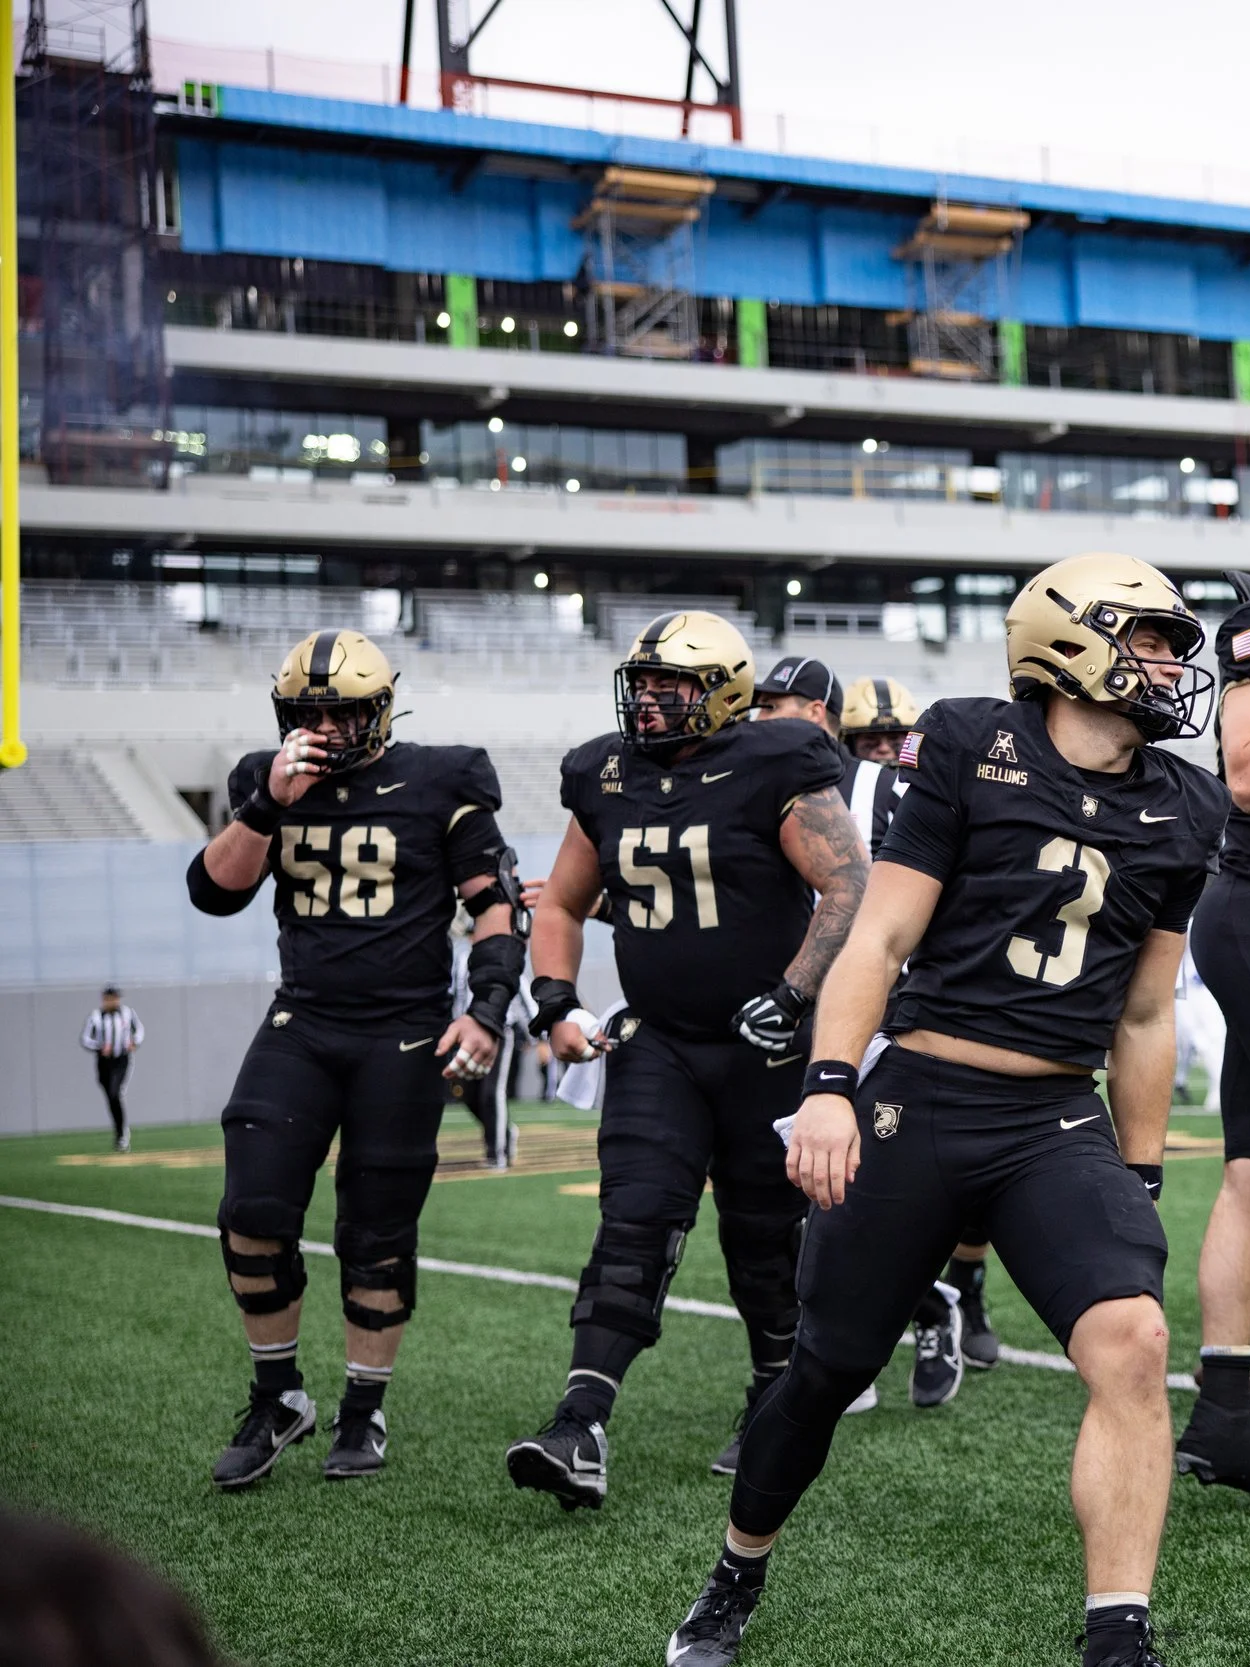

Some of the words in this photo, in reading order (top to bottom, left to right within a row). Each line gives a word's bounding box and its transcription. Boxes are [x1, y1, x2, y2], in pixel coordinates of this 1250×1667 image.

[977, 764, 1028, 786] HELLUMS
[988, 730, 1018, 763] A
[280, 826, 397, 917] 58
[619, 824, 719, 929] 51
[1006, 836, 1111, 987] 3
